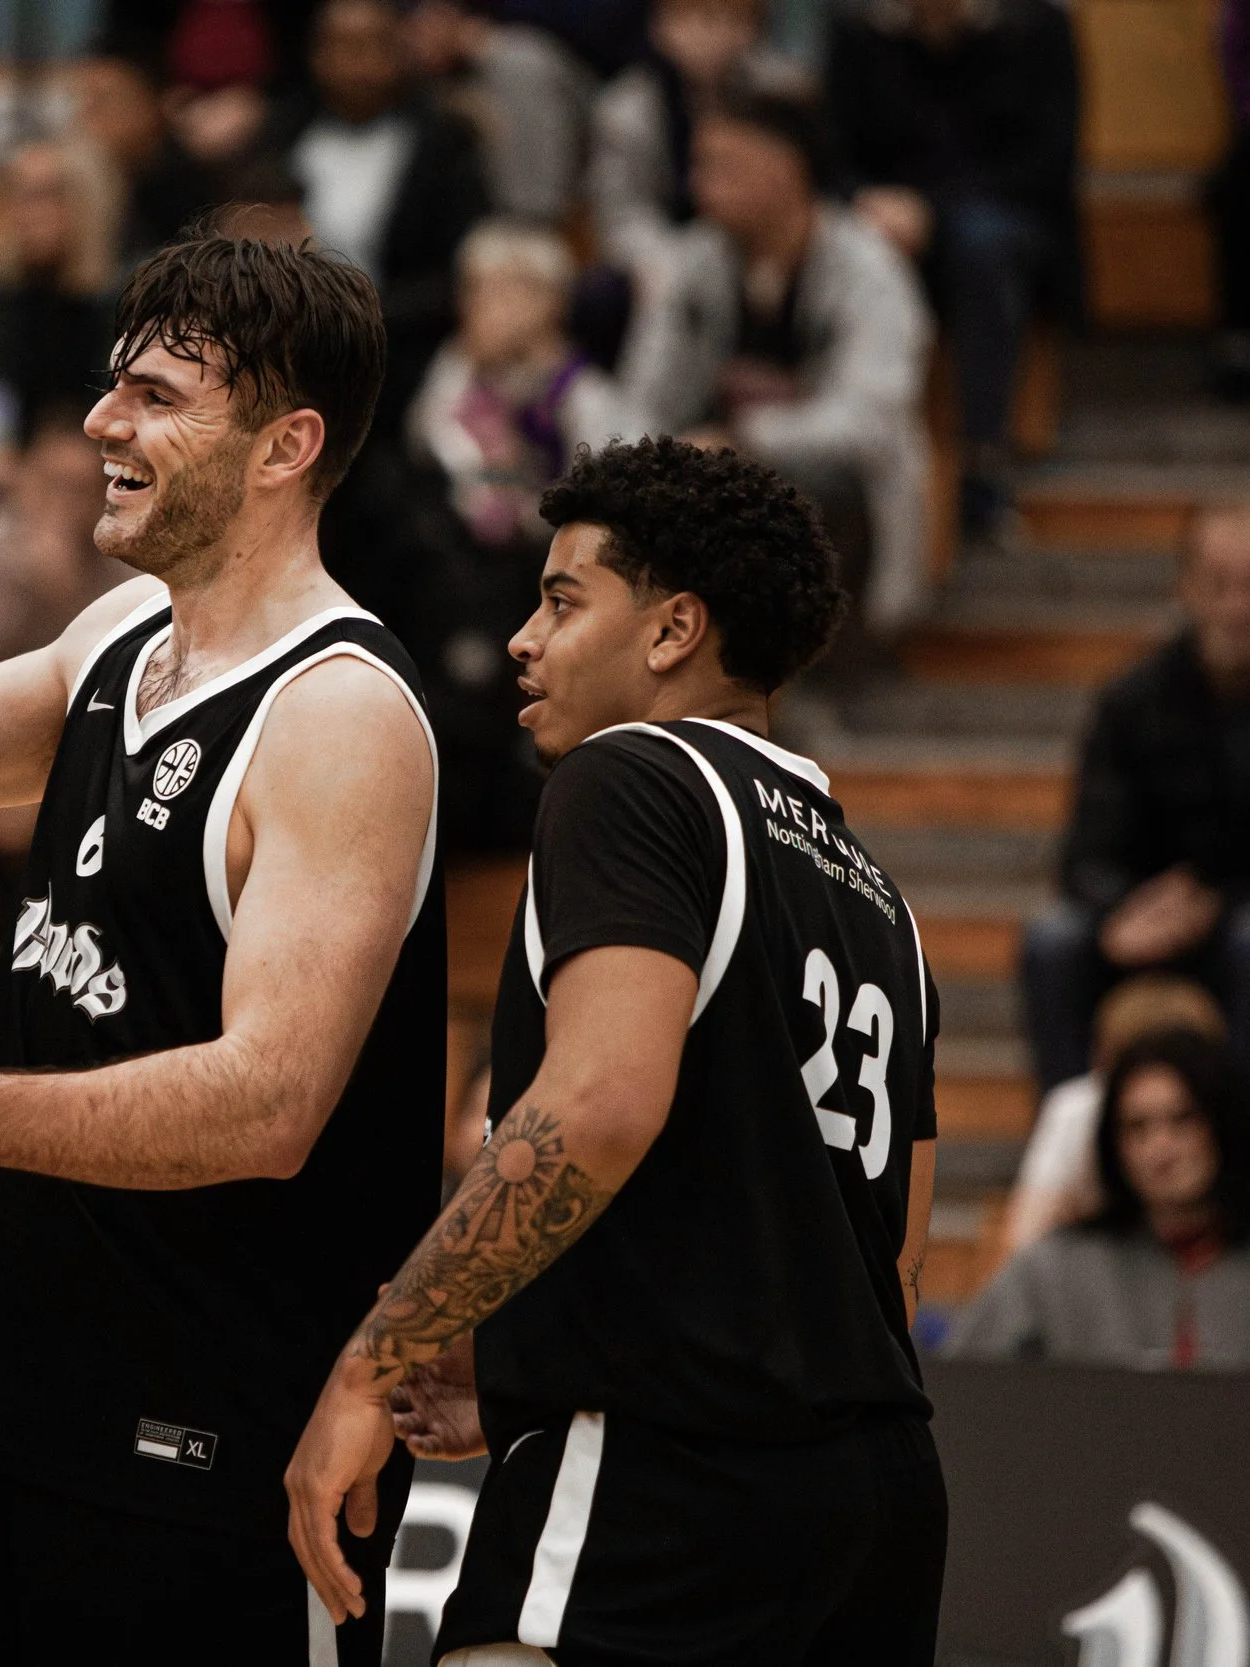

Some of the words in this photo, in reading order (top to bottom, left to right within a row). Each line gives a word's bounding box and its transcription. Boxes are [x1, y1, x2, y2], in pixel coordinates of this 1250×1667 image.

[136, 798, 171, 831] BCB
[76, 814, 105, 877] 6
[848, 867, 896, 926] Sherwood
[800, 947, 894, 1180] 23
[186, 1440, 207, 1459] XL
